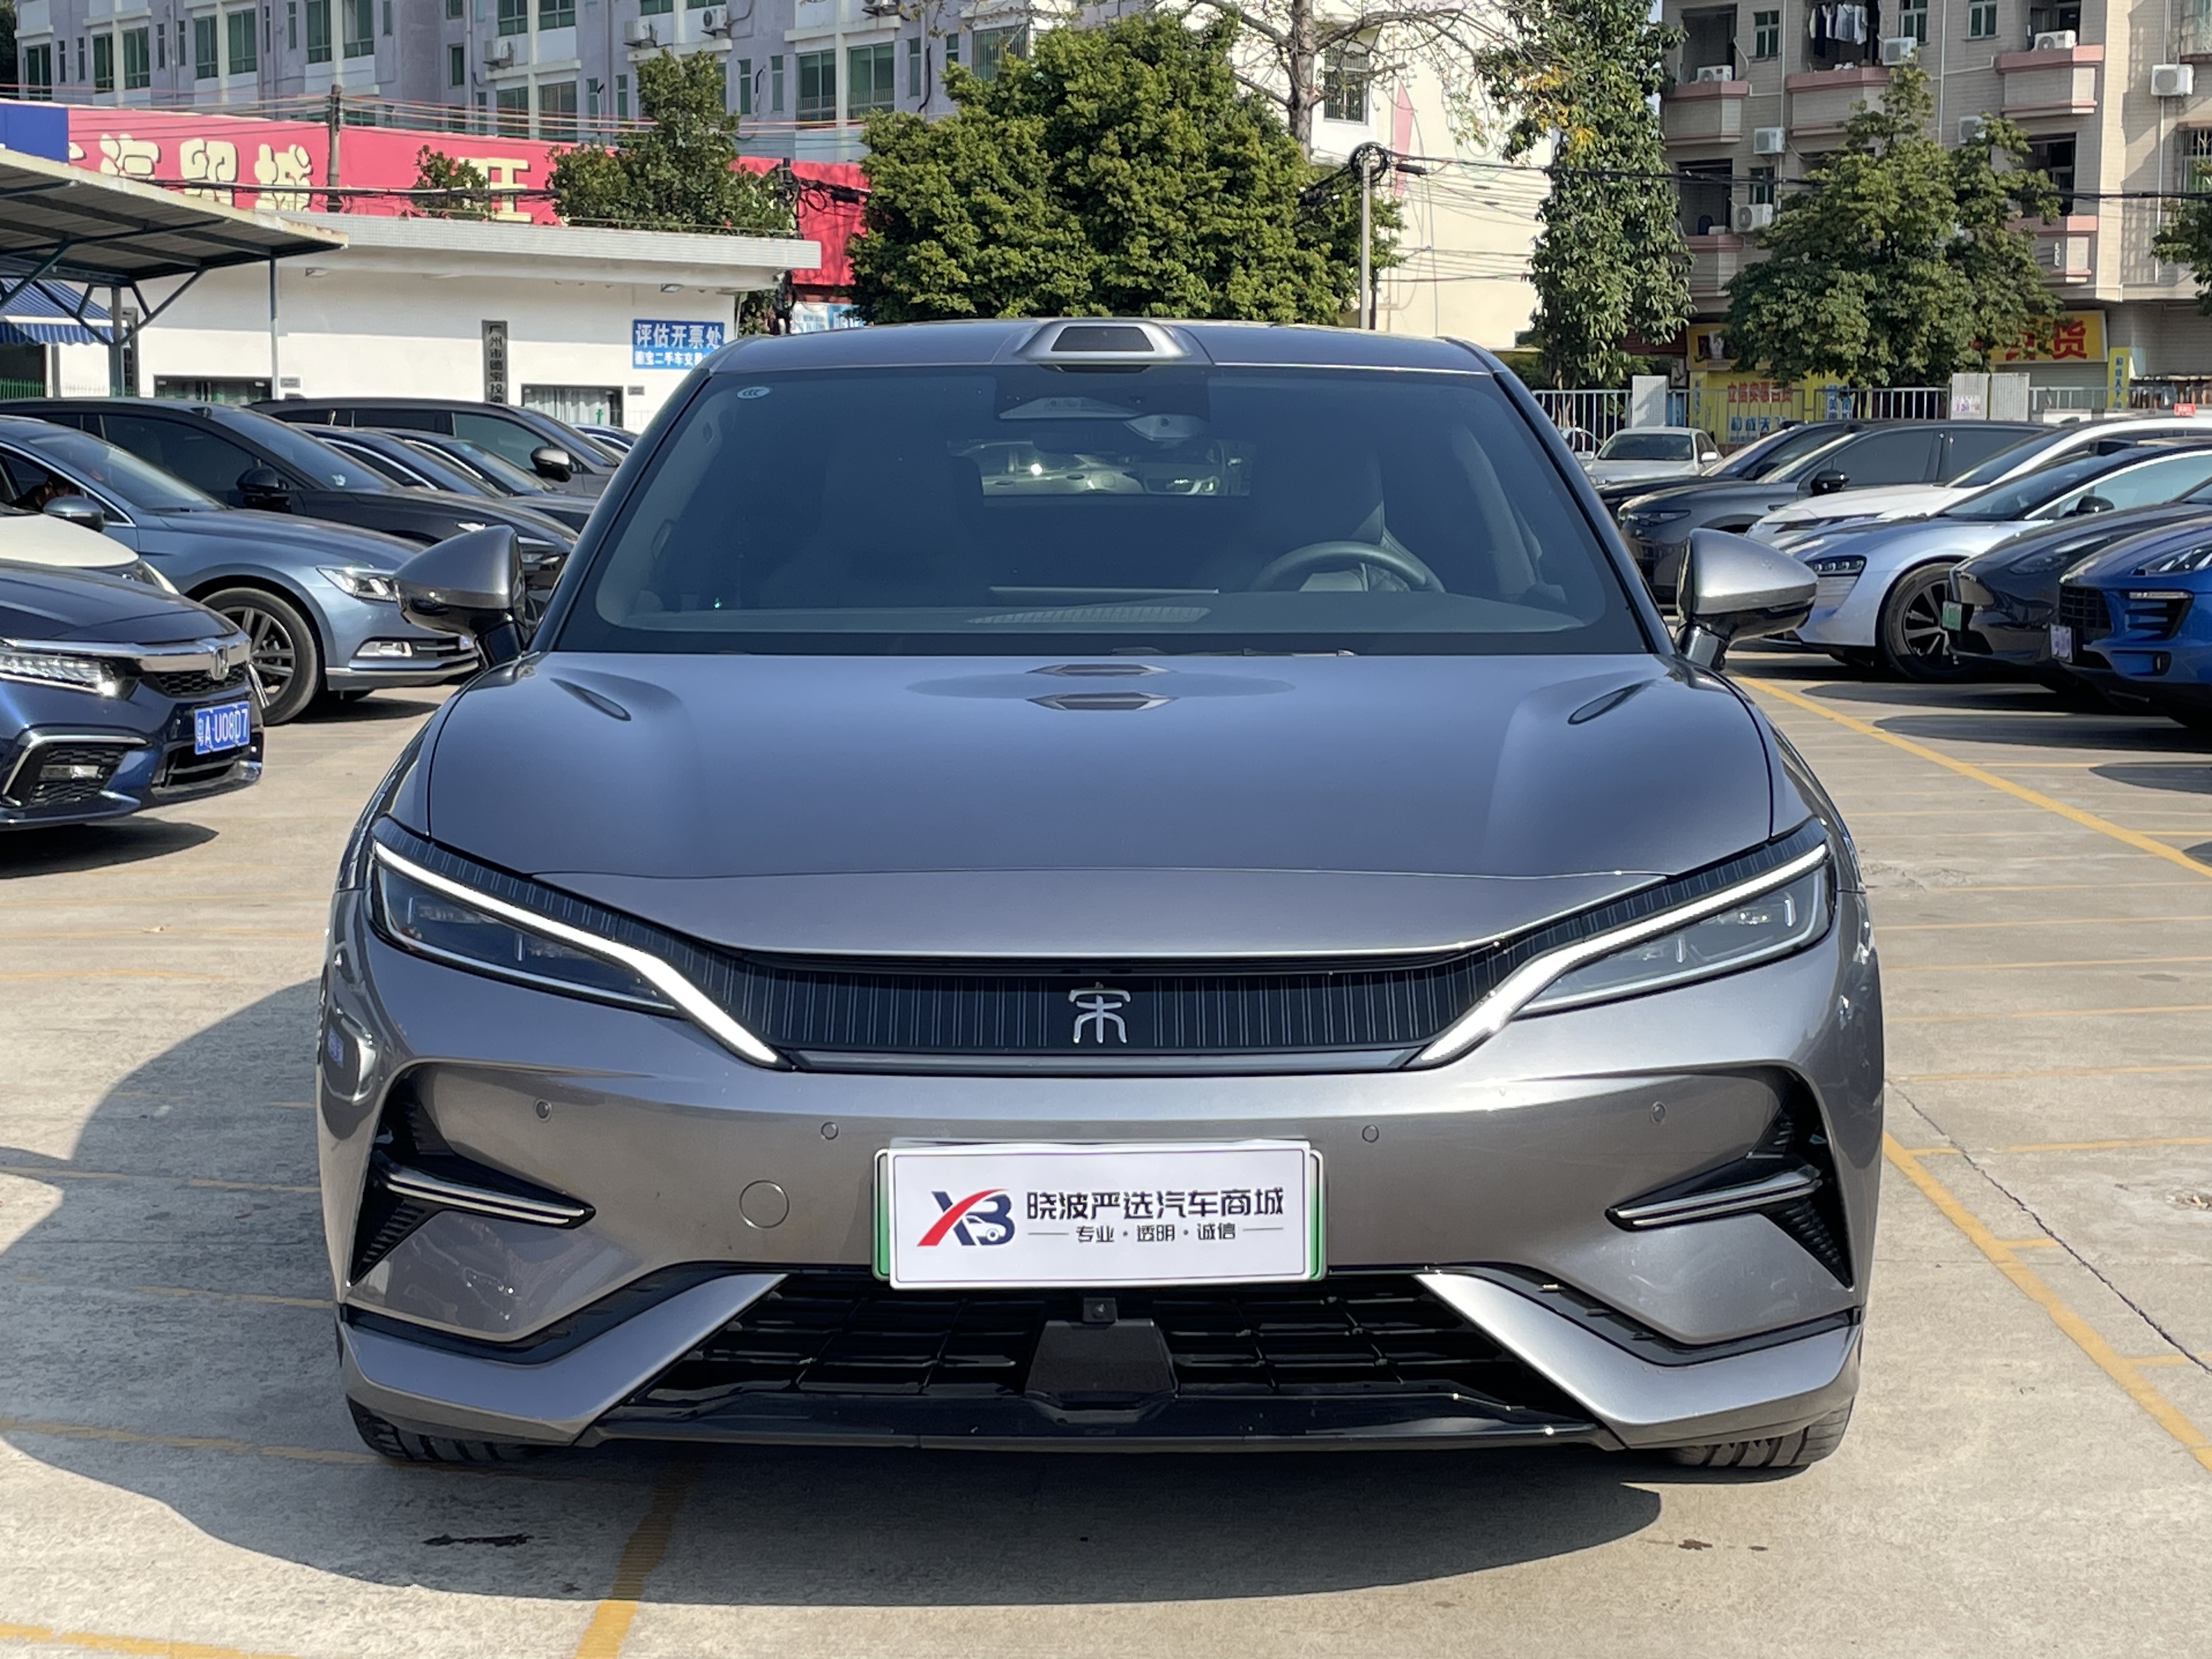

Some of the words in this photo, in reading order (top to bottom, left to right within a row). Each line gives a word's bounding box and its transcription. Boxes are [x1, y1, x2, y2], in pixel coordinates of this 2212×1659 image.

[635, 323, 721, 349] 评估开票处
[1027, 1187, 1284, 1220] 晓波严选汽车商城
